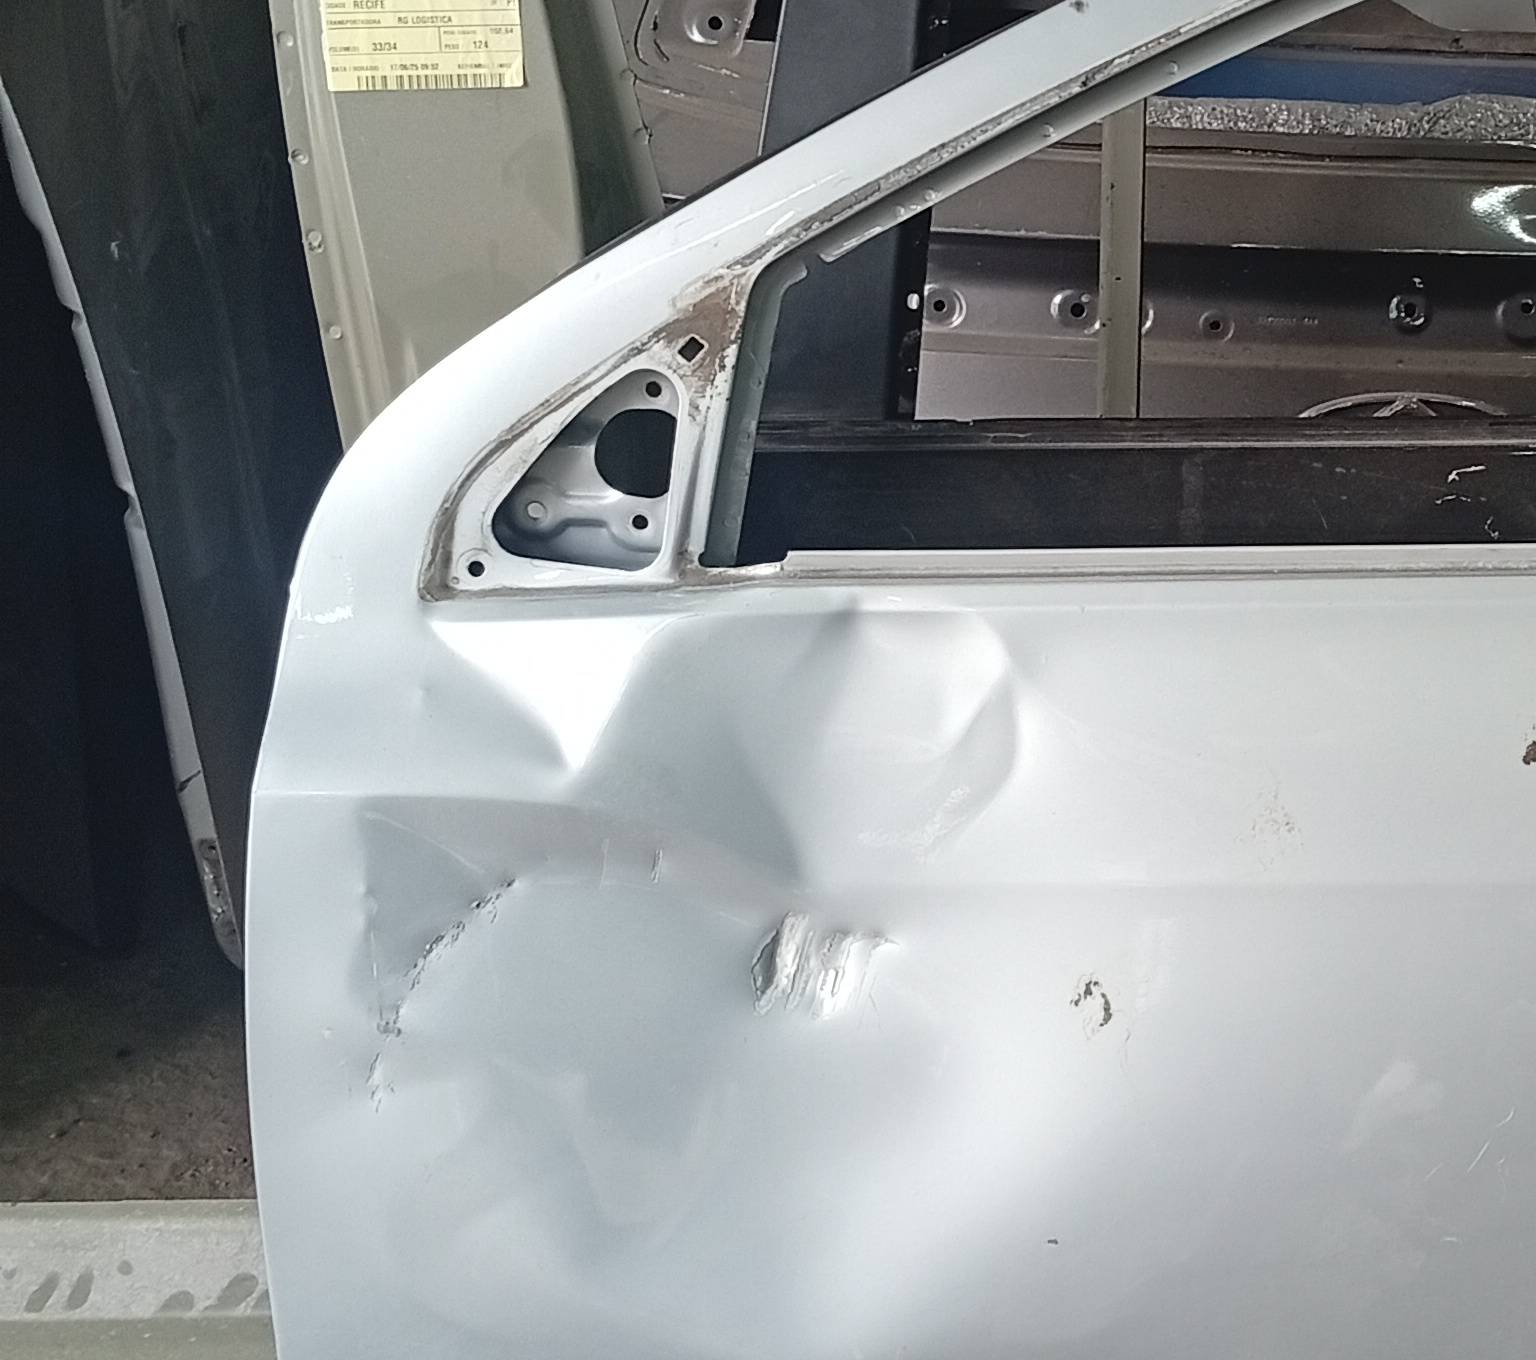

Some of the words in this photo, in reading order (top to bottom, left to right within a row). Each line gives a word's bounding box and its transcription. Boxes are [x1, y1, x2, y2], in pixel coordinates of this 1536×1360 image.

[353, 0, 385, 9] RECIFE
[411, 15, 453, 24] LOGISTICA
[372, 42, 398, 52] 33/34
[472, 40, 488, 50] 124
